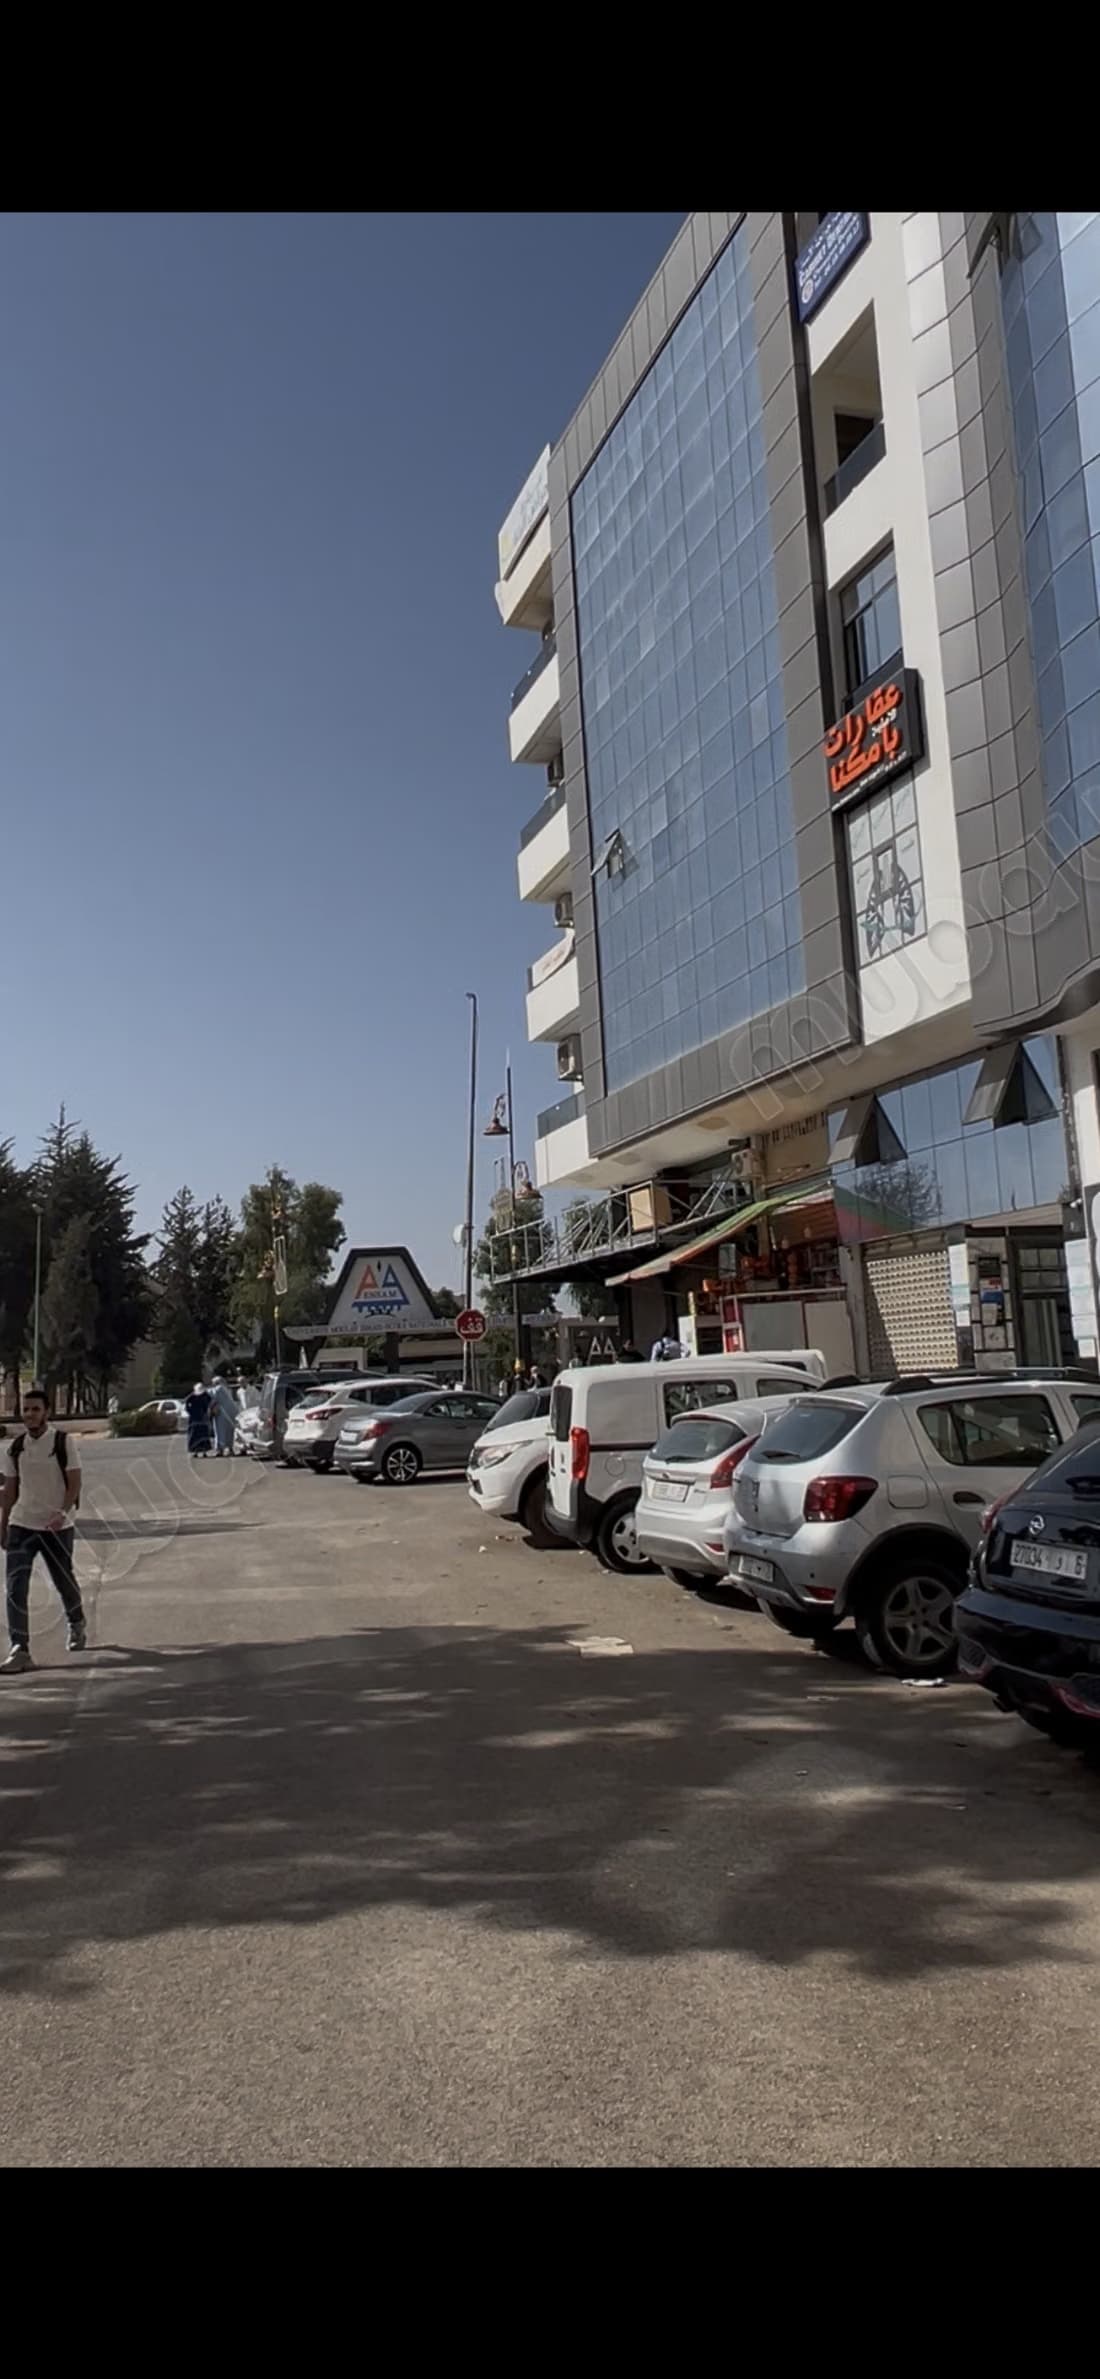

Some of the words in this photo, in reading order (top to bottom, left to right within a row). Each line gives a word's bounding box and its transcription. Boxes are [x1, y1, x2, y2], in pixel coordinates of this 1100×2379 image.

[460, 1317, 483, 1334] قف
[1013, 1543, 1042, 1567] 27034
[1075, 1555, 1083, 1576] 6
